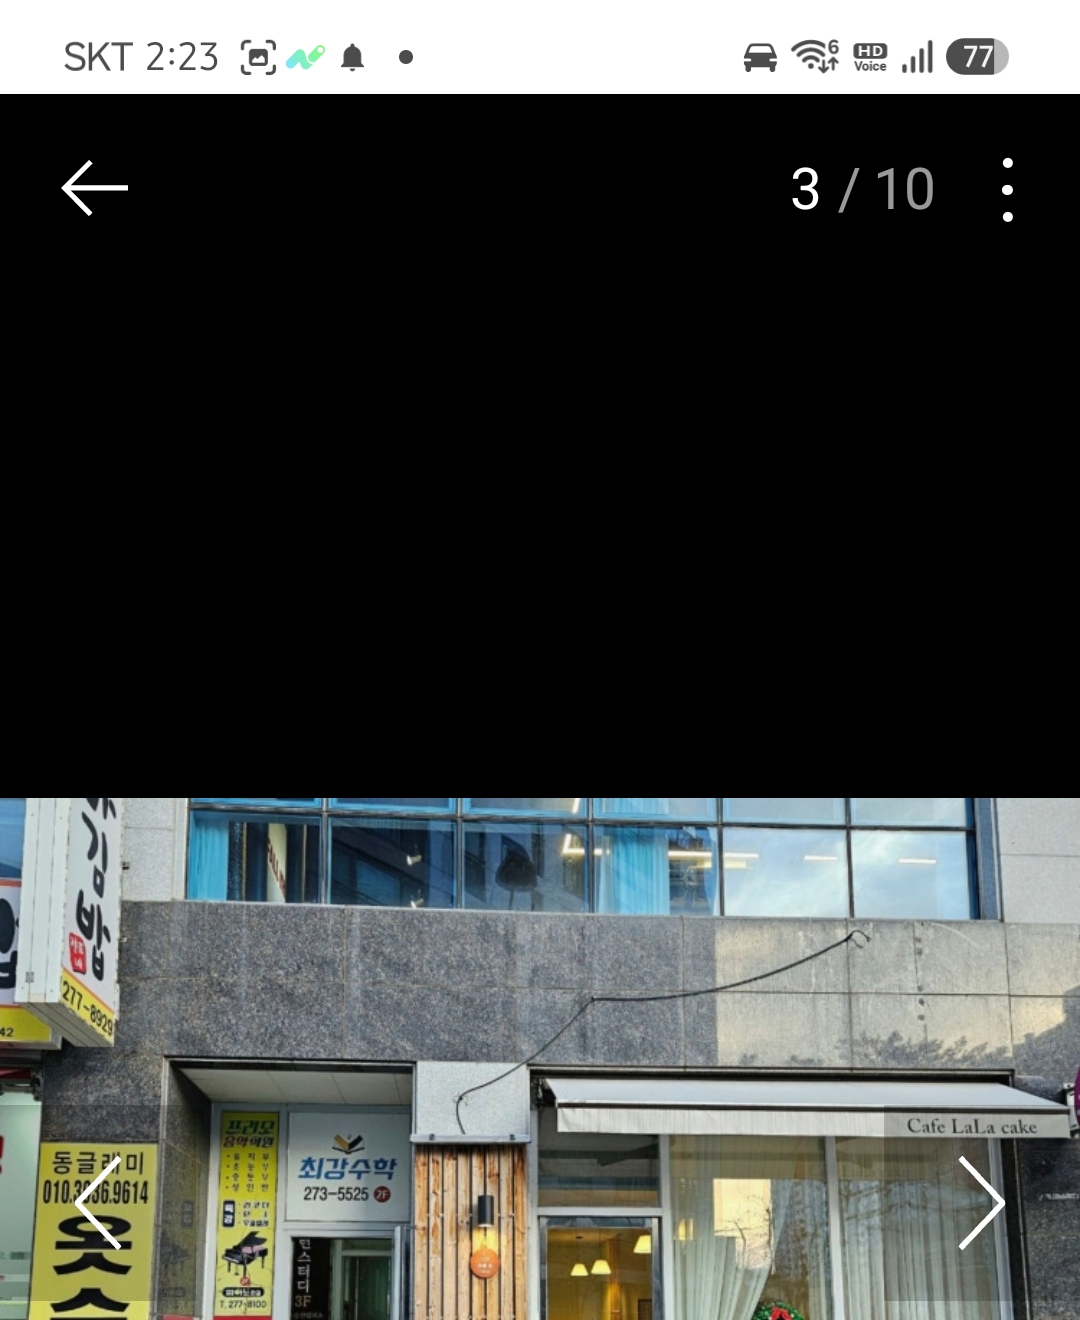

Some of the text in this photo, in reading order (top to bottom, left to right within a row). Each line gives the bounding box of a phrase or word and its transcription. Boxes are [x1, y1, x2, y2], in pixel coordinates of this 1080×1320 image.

[62, 980, 114, 1036] 277-8929
[907, 1118, 1038, 1134] Cafe LaLa cake
[52, 1151, 144, 1175] 동글래미
[298, 1156, 397, 1181] 최강수학
[303, 1187, 388, 1201] 273-5525 2F
[294, 1295, 311, 1307] 3F
